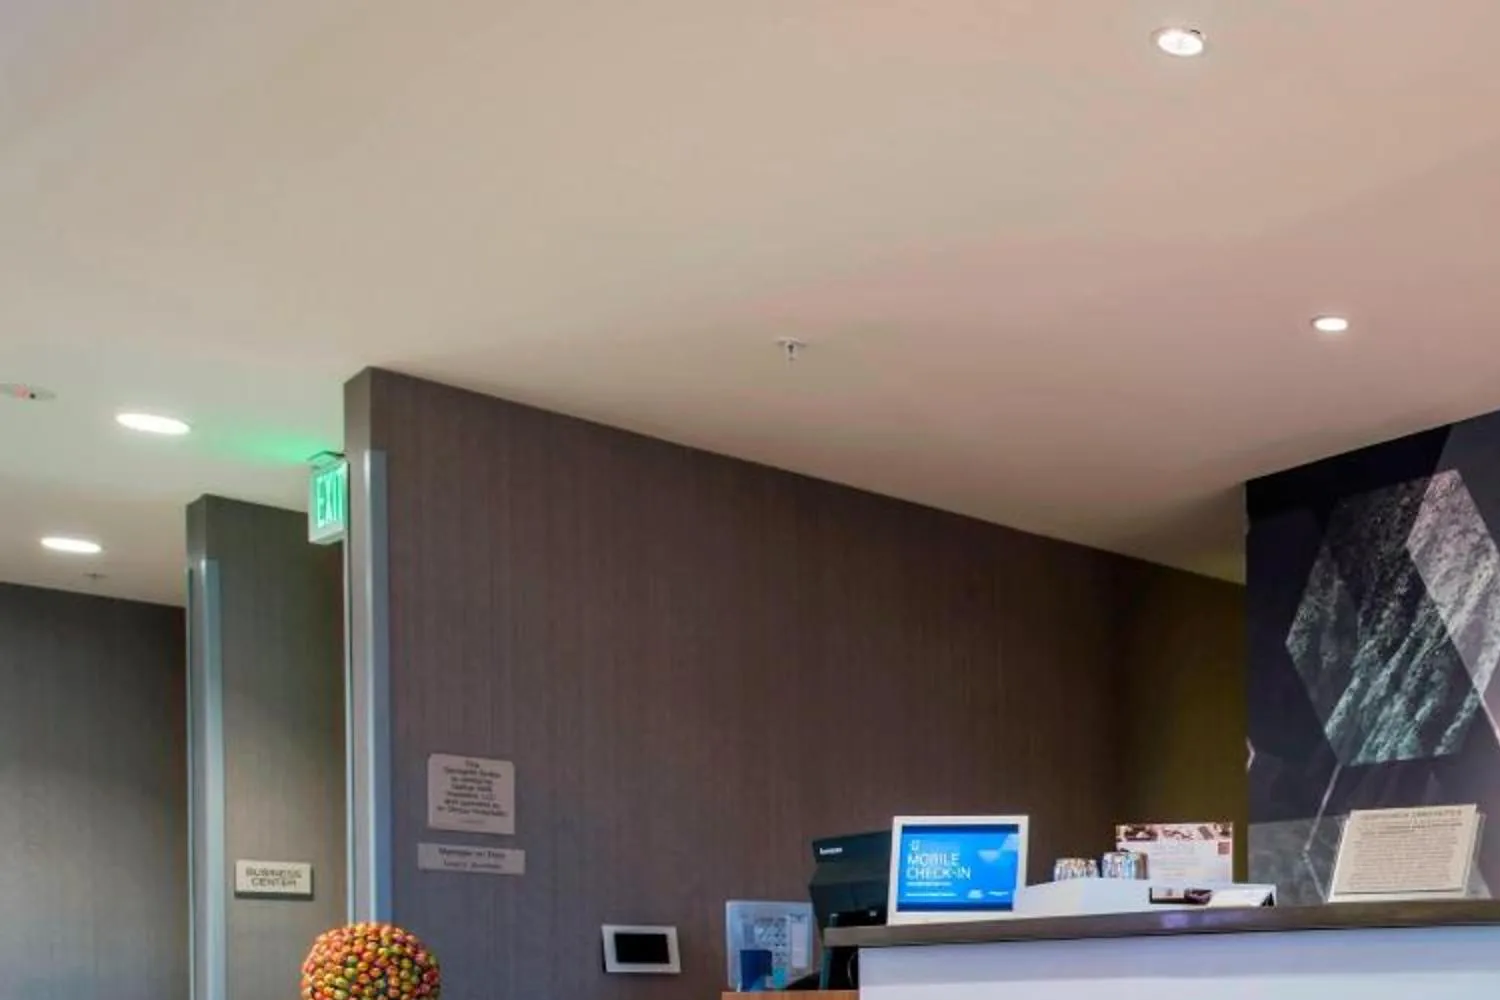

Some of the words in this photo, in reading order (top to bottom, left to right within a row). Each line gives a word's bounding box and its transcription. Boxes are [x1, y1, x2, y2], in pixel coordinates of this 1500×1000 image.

[316, 471, 343, 528] EXIT
[907, 852, 960, 866] MOBILE
[246, 867, 302, 878] BUSINESS
[905, 866, 971, 880] CHECK-IN
[251, 878, 297, 888] CENTER
